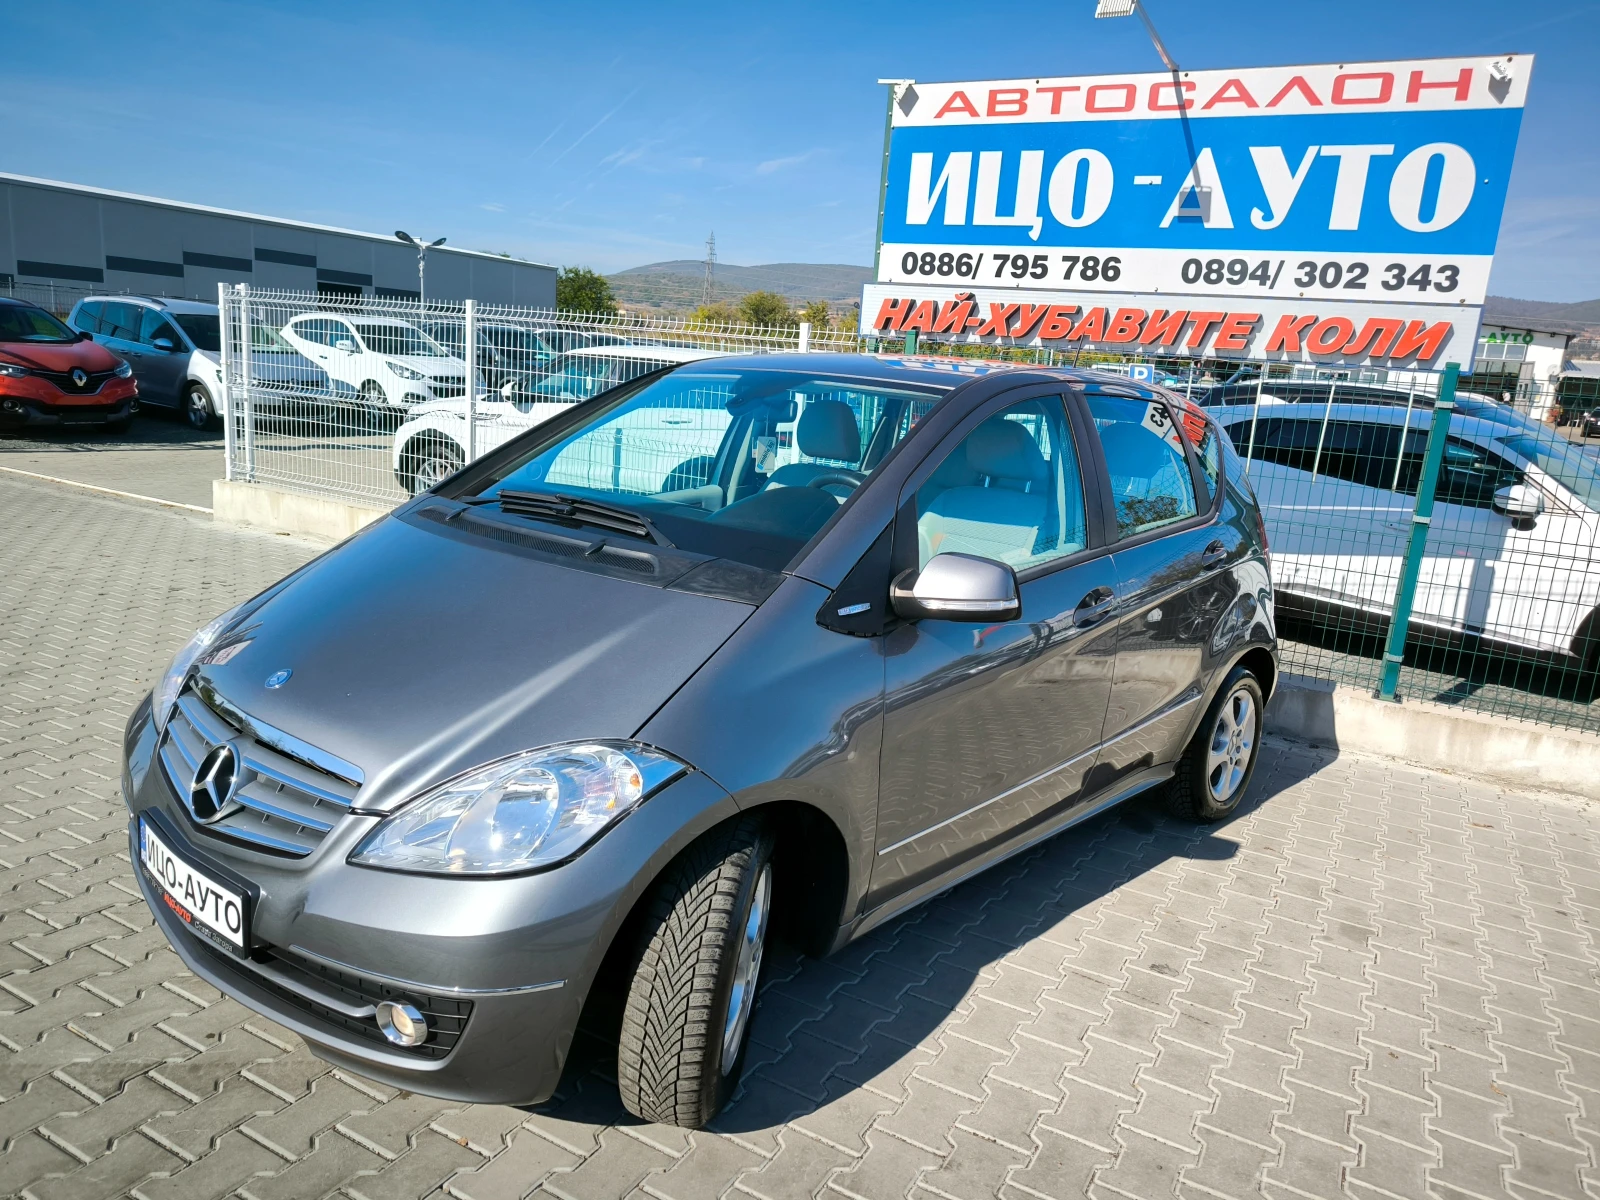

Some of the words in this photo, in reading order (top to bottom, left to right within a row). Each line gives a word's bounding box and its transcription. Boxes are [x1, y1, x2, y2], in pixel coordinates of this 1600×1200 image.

[934, 68, 1474, 118] АВТОСАЛОН
[901, 251, 983, 280] 0886/
[993, 254, 1048, 279] 795
[1061, 255, 1121, 282] 786
[1181, 258, 1285, 289] 0894/
[1294, 261, 1369, 289] 302
[1381, 263, 1460, 293] 343
[873, 292, 1261, 349] НАЙ-ХУБАВИТЕ
[1265, 314, 1452, 360] КОЛИ
[147, 833, 241, 934] ИЦО-АУТО
